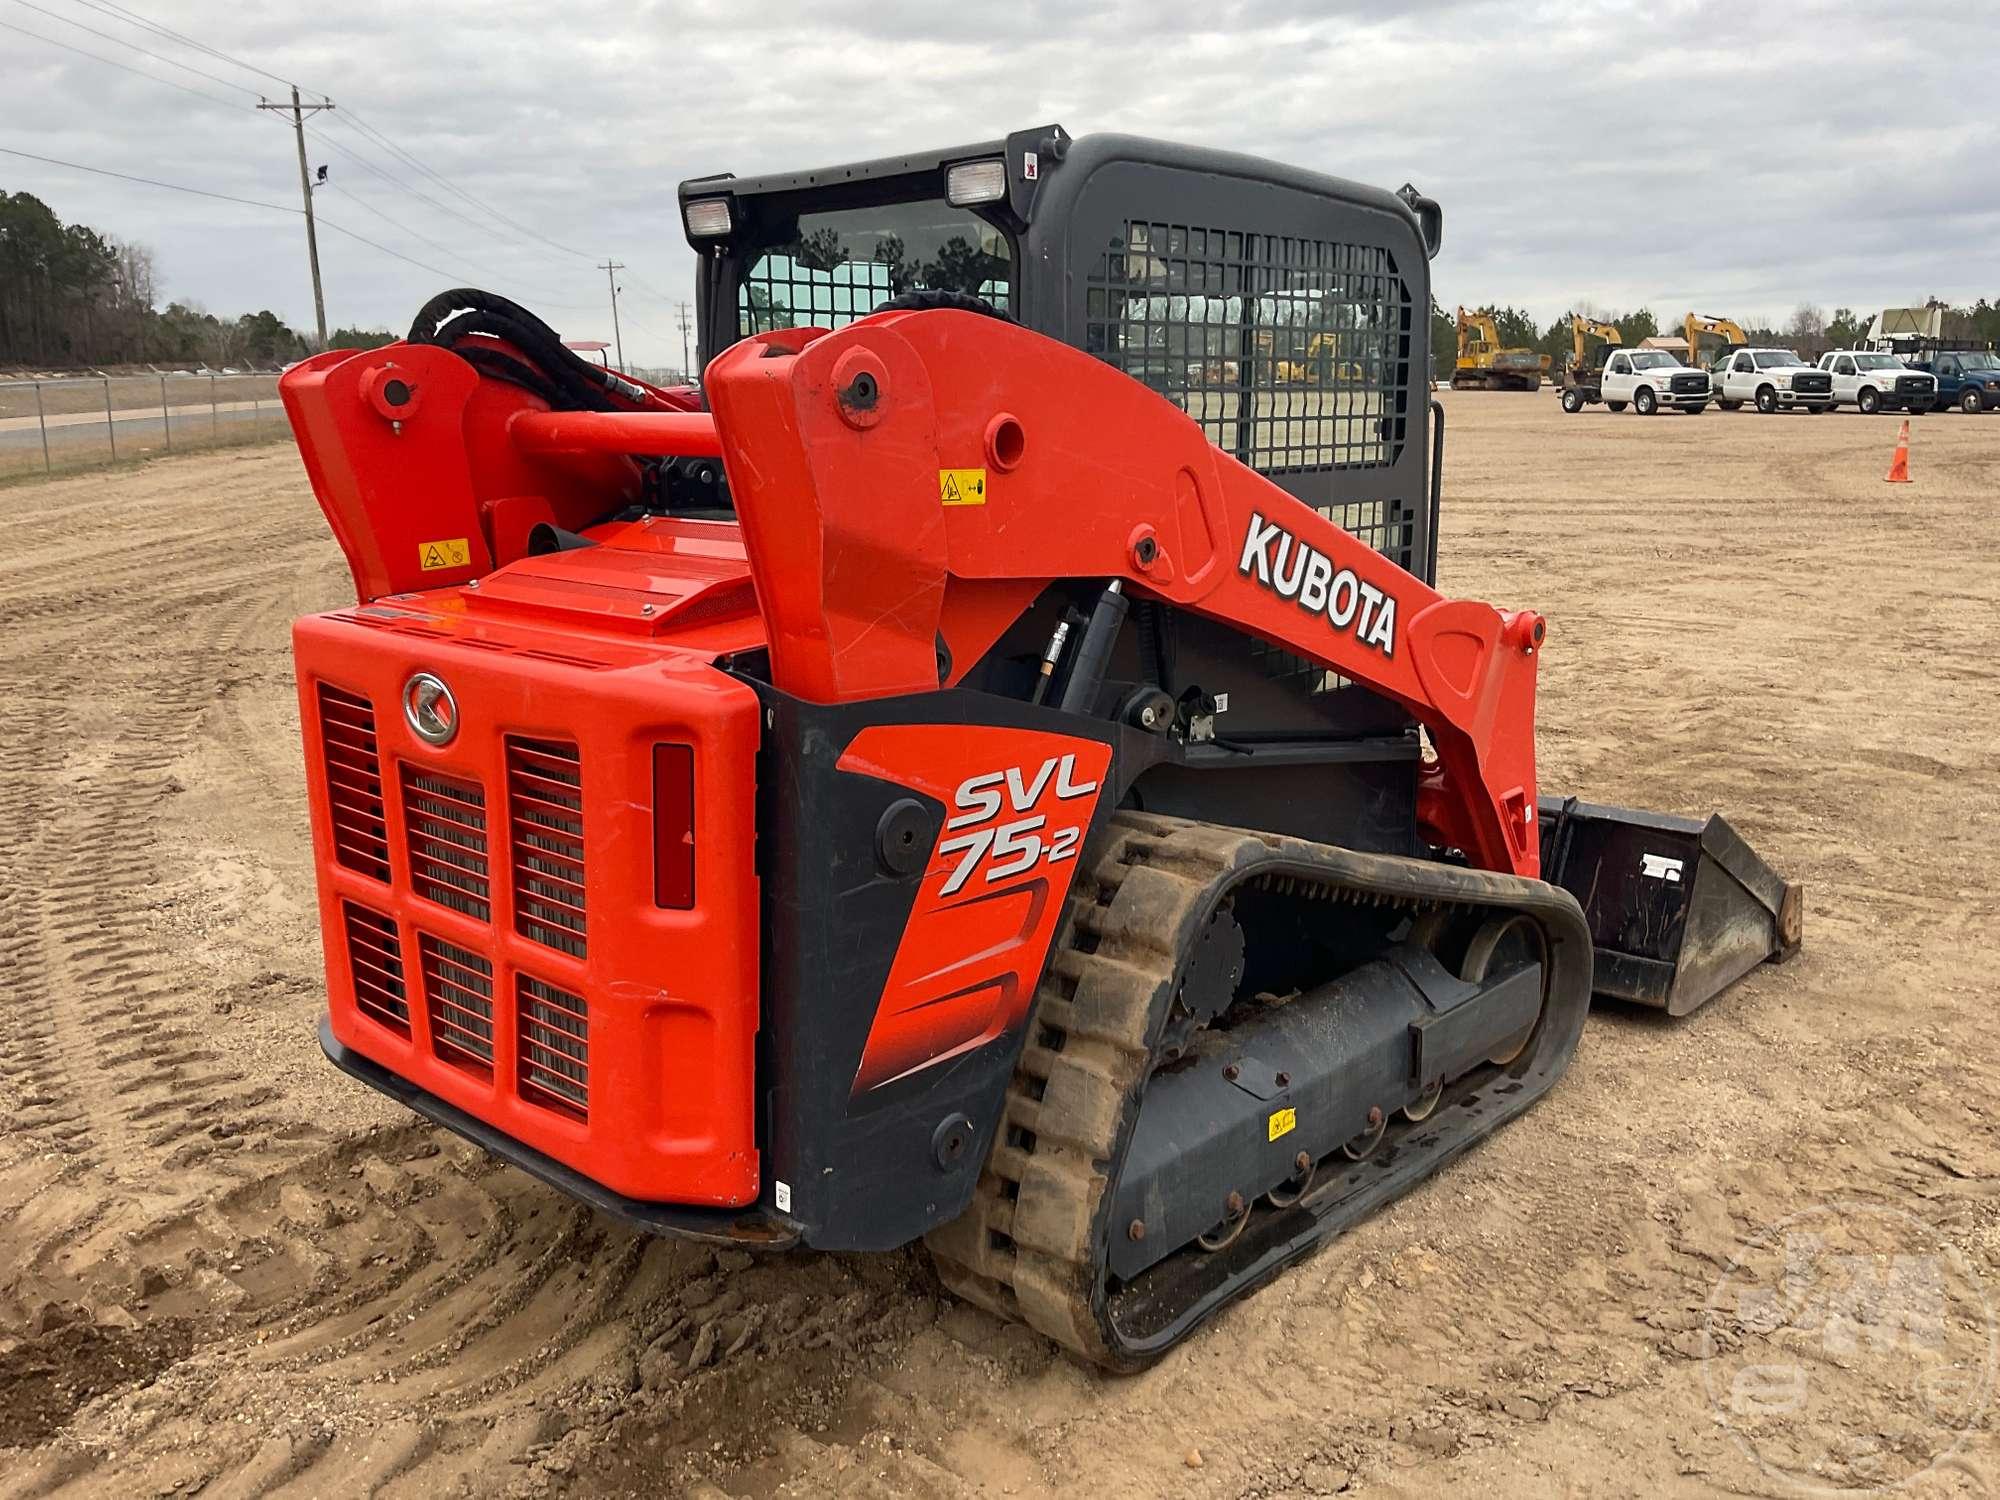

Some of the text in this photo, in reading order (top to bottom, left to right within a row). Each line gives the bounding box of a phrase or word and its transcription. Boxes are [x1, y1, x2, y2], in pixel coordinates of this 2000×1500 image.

[1238, 511, 1396, 657] KUBOTA
[946, 754, 1097, 830] SVL
[938, 814, 1080, 897] 75-2
